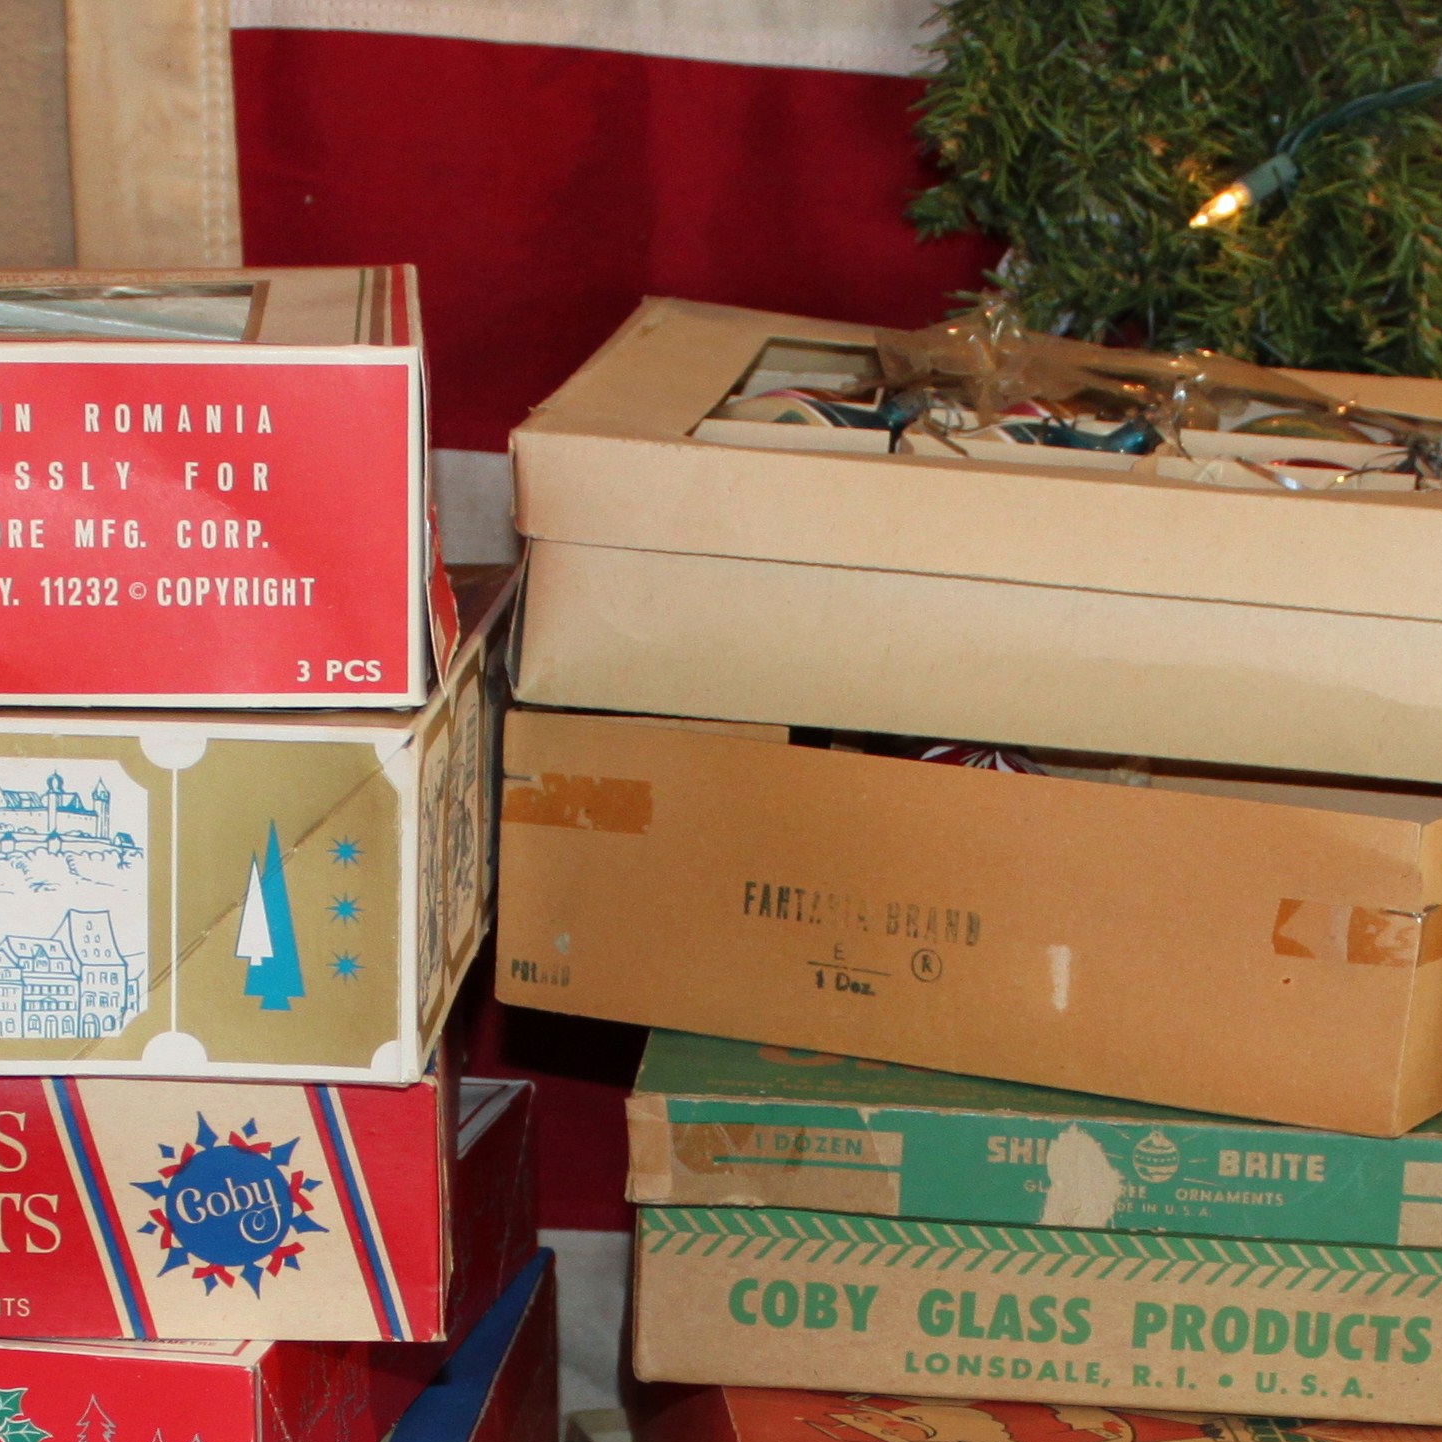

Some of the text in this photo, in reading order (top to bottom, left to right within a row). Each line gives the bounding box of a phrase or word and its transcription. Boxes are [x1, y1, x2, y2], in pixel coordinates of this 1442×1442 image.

[85, 404, 274, 435] ROMANIA
[185, 463, 270, 492] FOR
[74, 519, 147, 549] MFG.
[176, 519, 270, 550] CORP.
[40, 577, 119, 606] 11232
[156, 577, 315, 606] COPYRIGHT
[297, 661, 382, 683] 3 PCS
[887, 902, 981, 946] BRAND
[774, 1132, 864, 1157] DOZEN
[986, 1136, 1327, 1182] SHI BRITE
[175, 1174, 284, 1248] Coby
[1119, 1184, 1285, 1207] REE ORNAMENTS
[728, 1278, 877, 1332] COBY
[917, 1287, 1091, 1345] GLASS
[1132, 1301, 1432, 1364] PRODUCTS
[905, 1352, 1112, 1388] LONSDALE,
